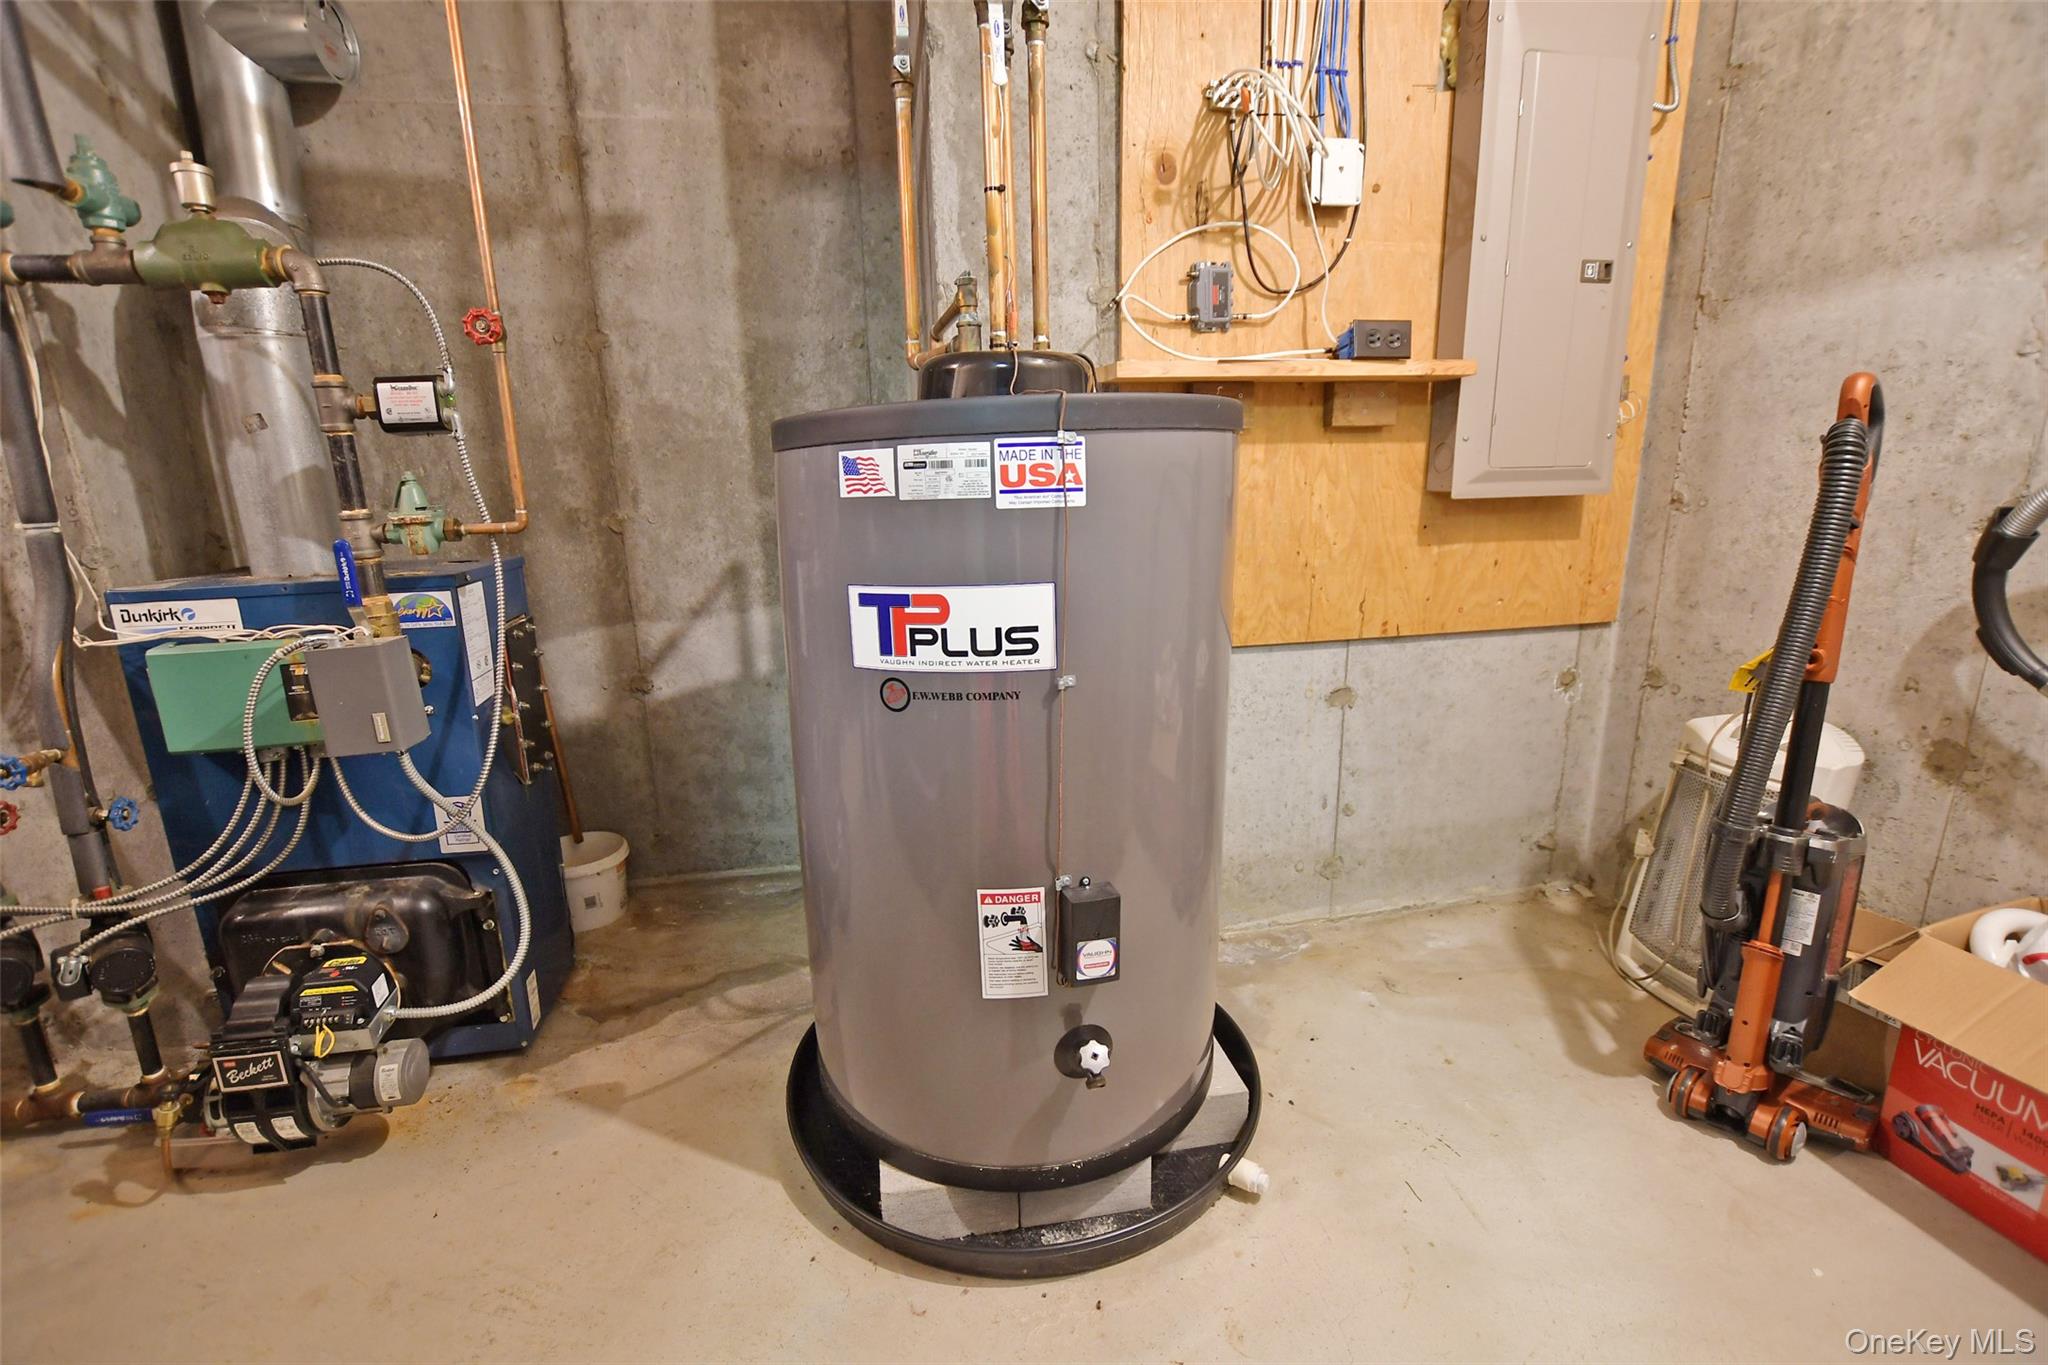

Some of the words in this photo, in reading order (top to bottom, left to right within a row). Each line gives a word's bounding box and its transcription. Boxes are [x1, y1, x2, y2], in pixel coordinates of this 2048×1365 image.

[999, 449, 1036, 461] MADE
[1041, 448, 1054, 460] IN
[1056, 447, 1082, 460] THE
[999, 462, 1084, 488] USA
[120, 607, 182, 623] Dunkirk
[909, 625, 1039, 658] PLUS
[879, 658, 915, 666] VAUGHN
[1002, 658, 1041, 666] HEATER
[967, 690, 1021, 701] COMPANY
[994, 894, 1039, 904] DANGER
[226, 1057, 274, 1084] Beckett
